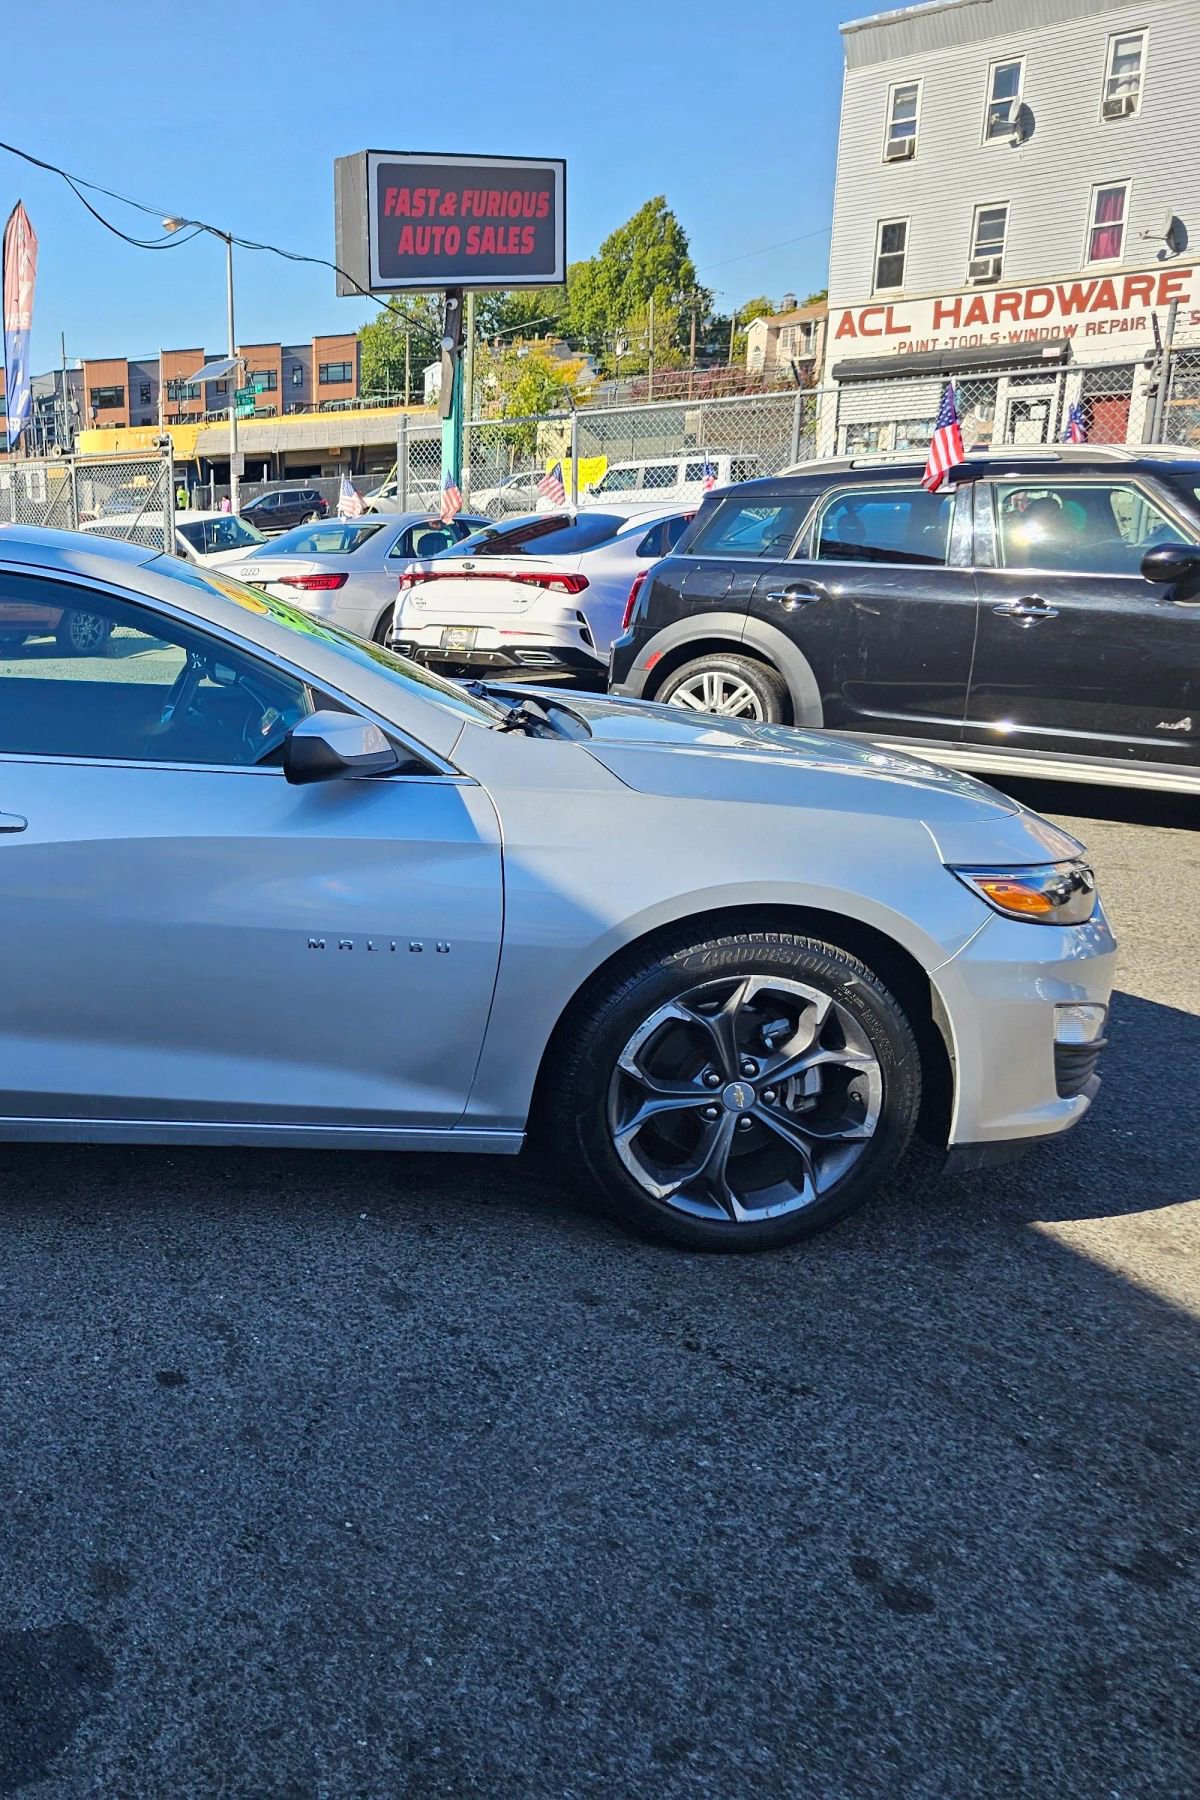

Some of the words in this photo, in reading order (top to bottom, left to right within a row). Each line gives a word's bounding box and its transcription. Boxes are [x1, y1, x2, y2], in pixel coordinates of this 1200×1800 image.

[384, 187, 441, 217] FAST
[439, 191, 457, 217] &
[460, 190, 549, 218] FURIOUS
[398, 225, 461, 256] AUTO
[466, 225, 535, 255] SALES
[834, 305, 912, 340] ACL
[932, 269, 1193, 330] HARDWARE
[1007, 323, 1079, 345] WINDOW
[1085, 316, 1147, 337] REPAIR
[307, 938, 451, 953] MALIBU
